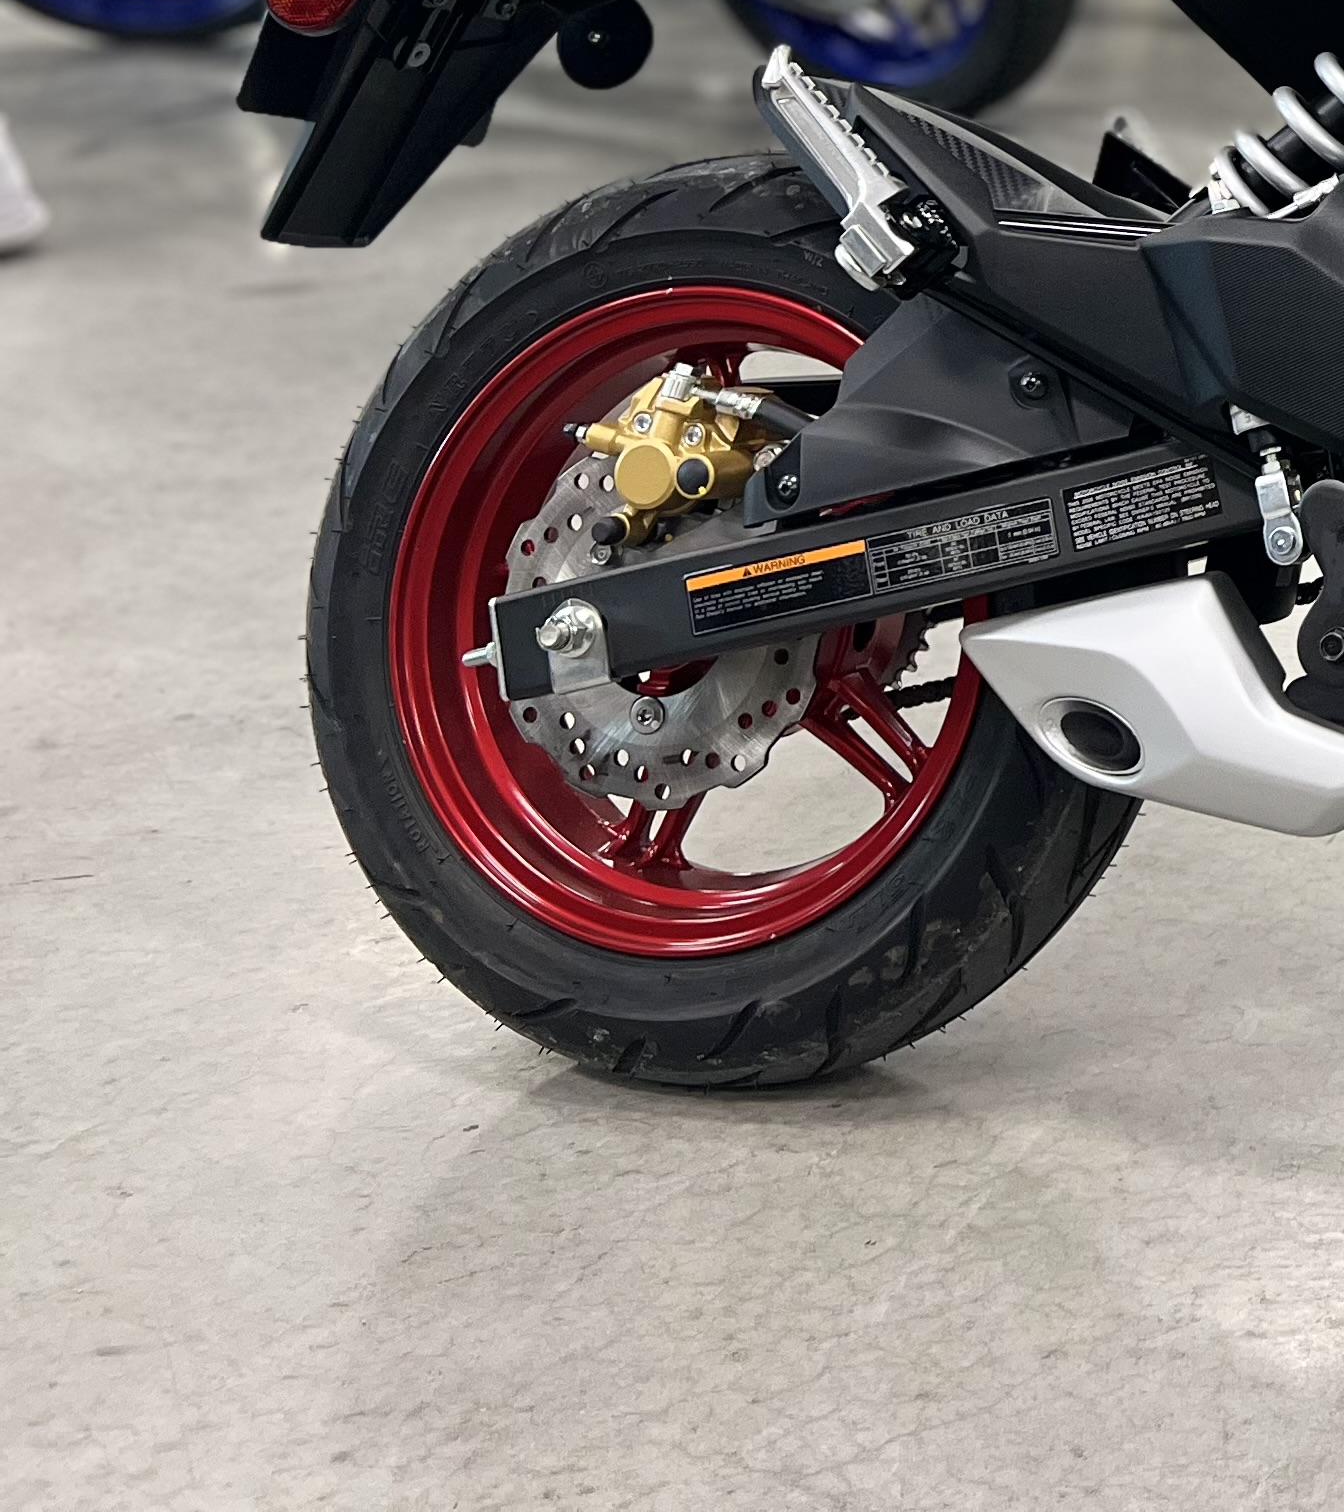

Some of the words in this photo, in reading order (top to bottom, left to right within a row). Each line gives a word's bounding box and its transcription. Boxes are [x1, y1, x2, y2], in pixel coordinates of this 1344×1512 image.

[906, 527, 928, 539] TIRE
[932, 523, 951, 534] AND
[955, 517, 980, 530] LOAD
[984, 510, 1009, 524] DATA
[752, 554, 806, 574] WARNING
